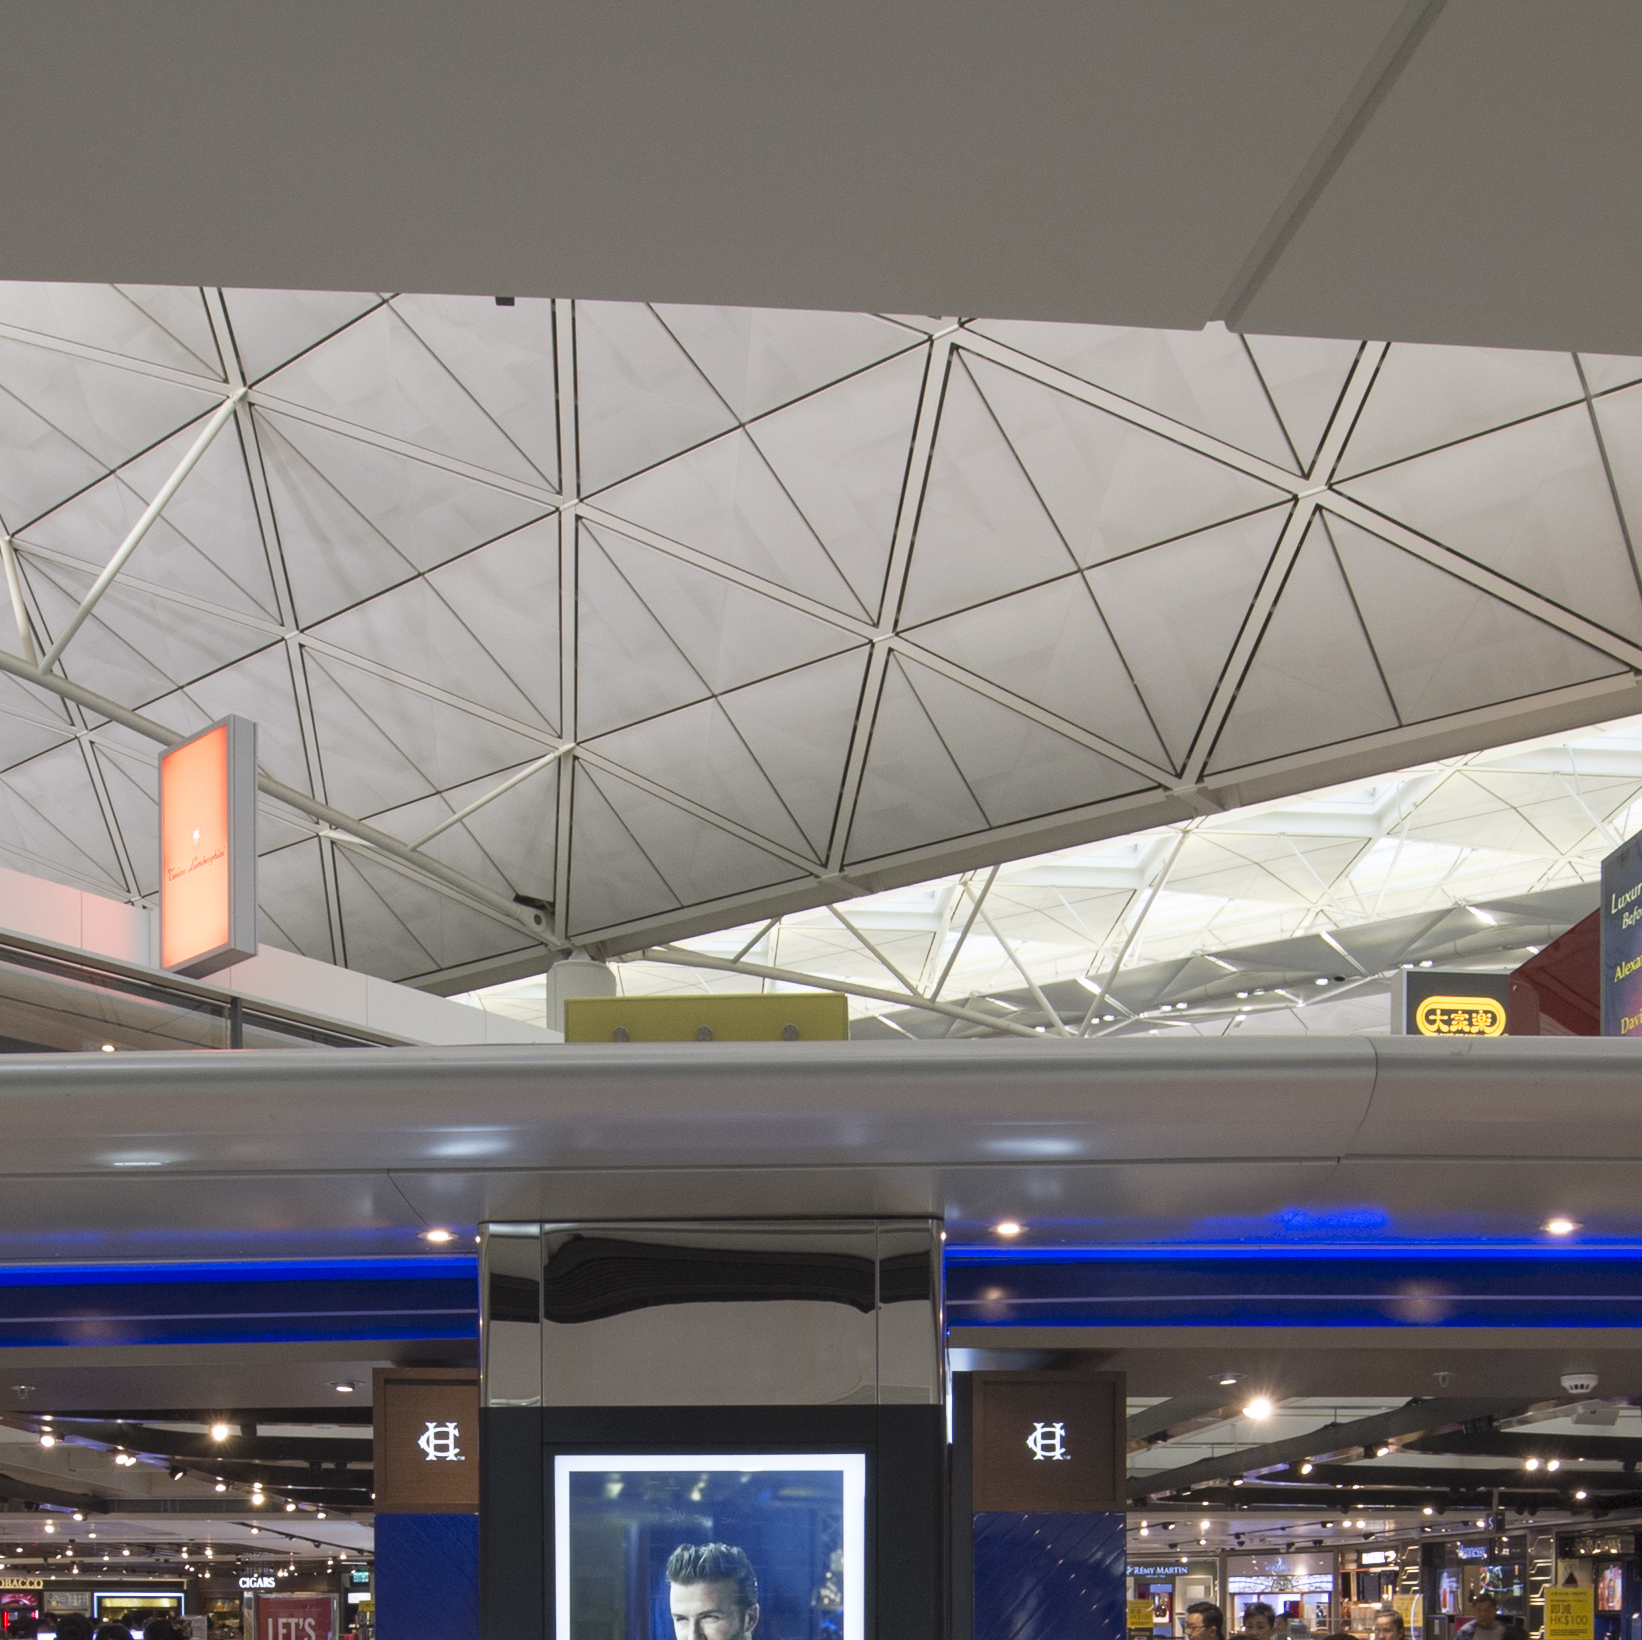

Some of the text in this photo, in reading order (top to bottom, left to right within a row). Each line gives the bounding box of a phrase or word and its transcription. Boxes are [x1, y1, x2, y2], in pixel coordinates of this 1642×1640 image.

[1157, 1566, 1188, 1574] MARTIN
[239, 1577, 275, 1588] CIGARS
[1550, 1615, 1588, 1626] HK$100
